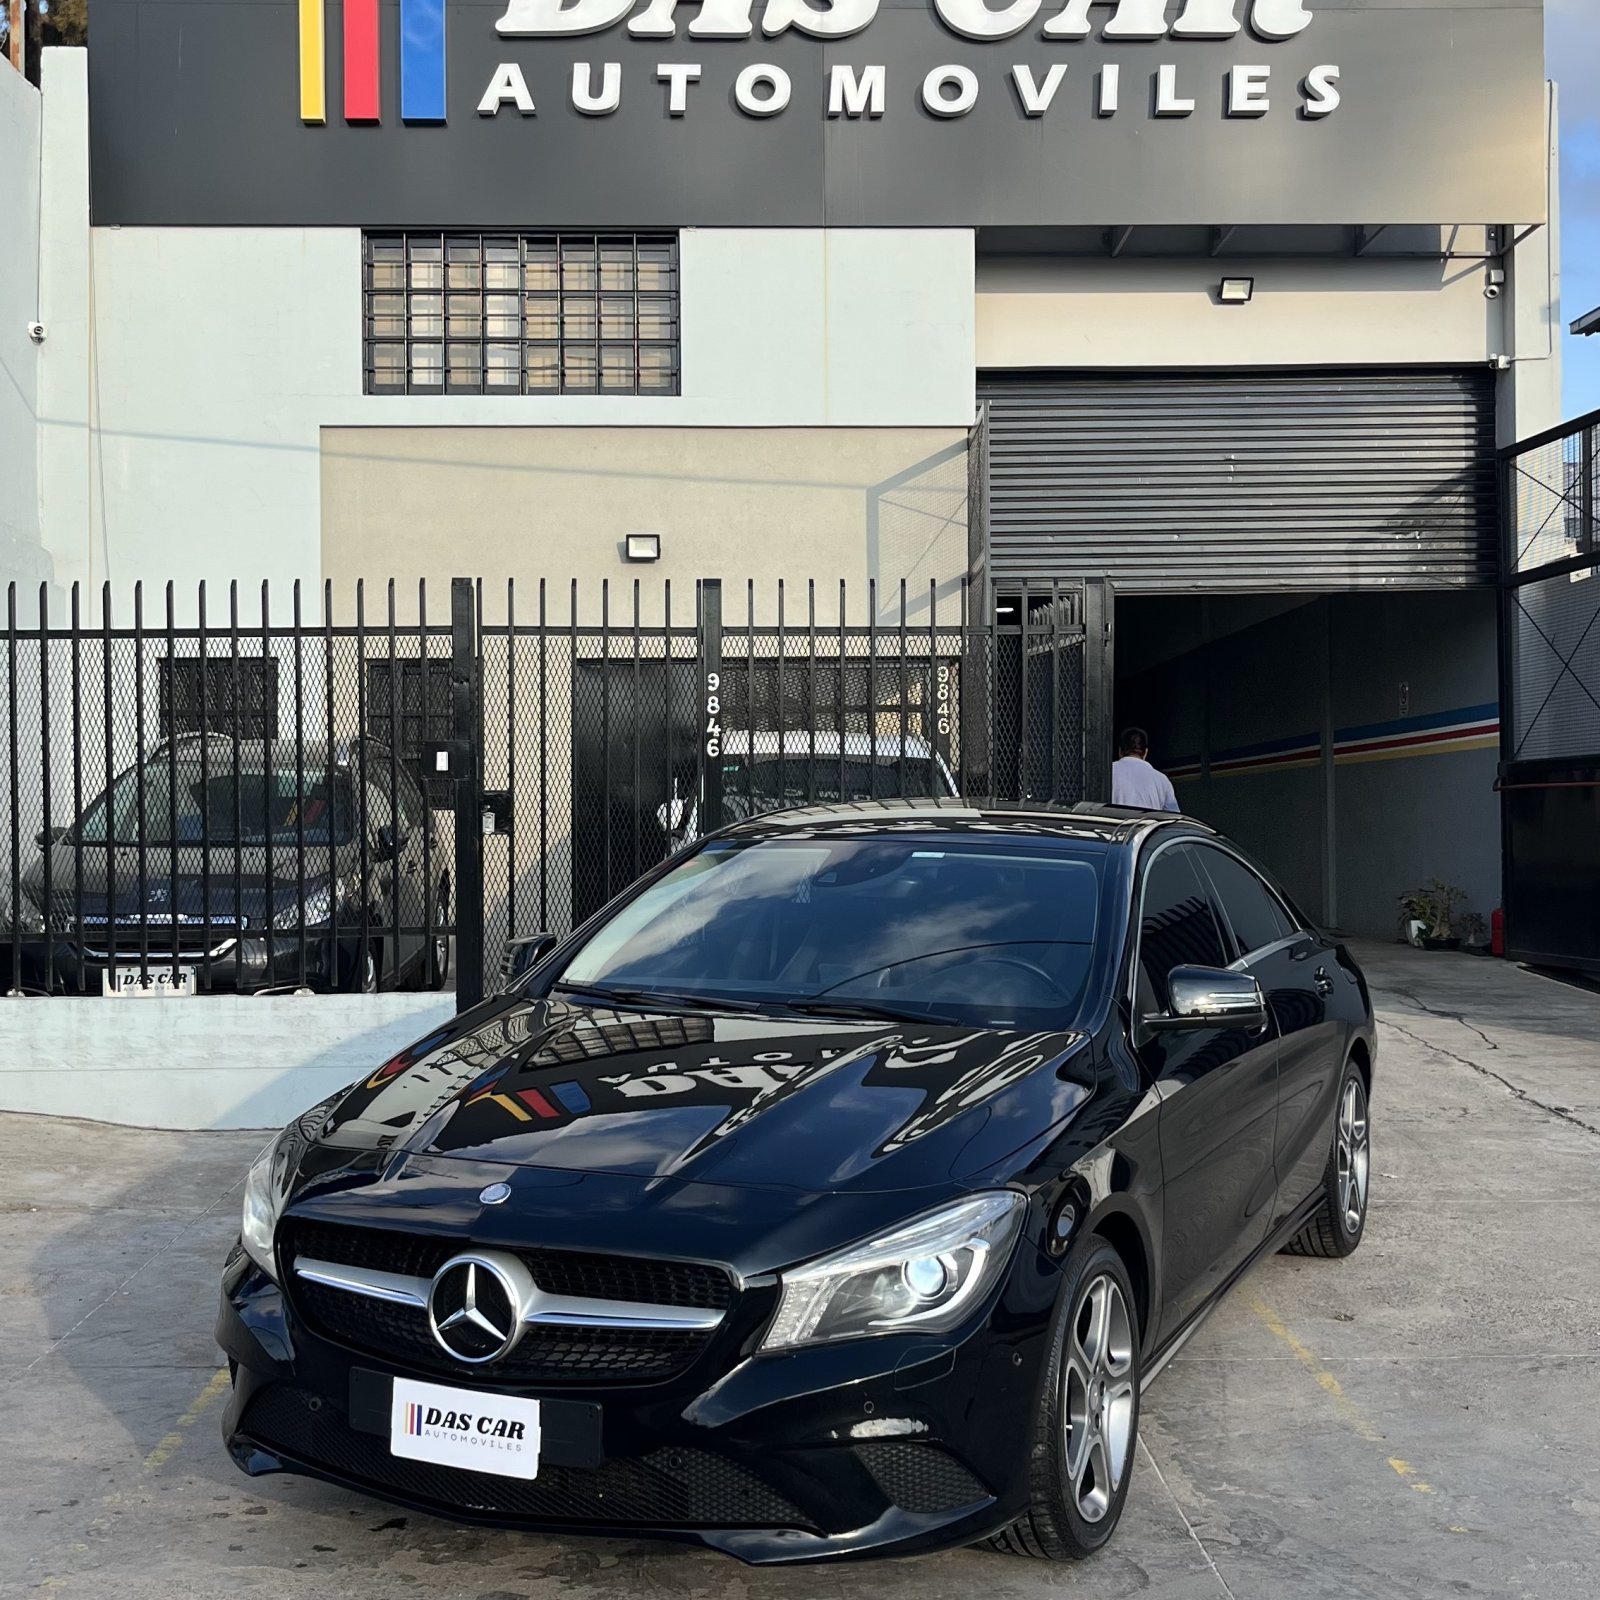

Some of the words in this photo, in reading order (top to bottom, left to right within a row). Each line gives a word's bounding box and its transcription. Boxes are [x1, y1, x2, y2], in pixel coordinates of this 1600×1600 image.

[477, 62, 1341, 118] AUTOMOVILES
[706, 672, 721, 757] 9846
[937, 665, 950, 735] 9846
[424, 1407, 473, 1431] DAS
[476, 1415, 526, 1440] CAR
[424, 1428, 523, 1452] AUTOMOVILES
